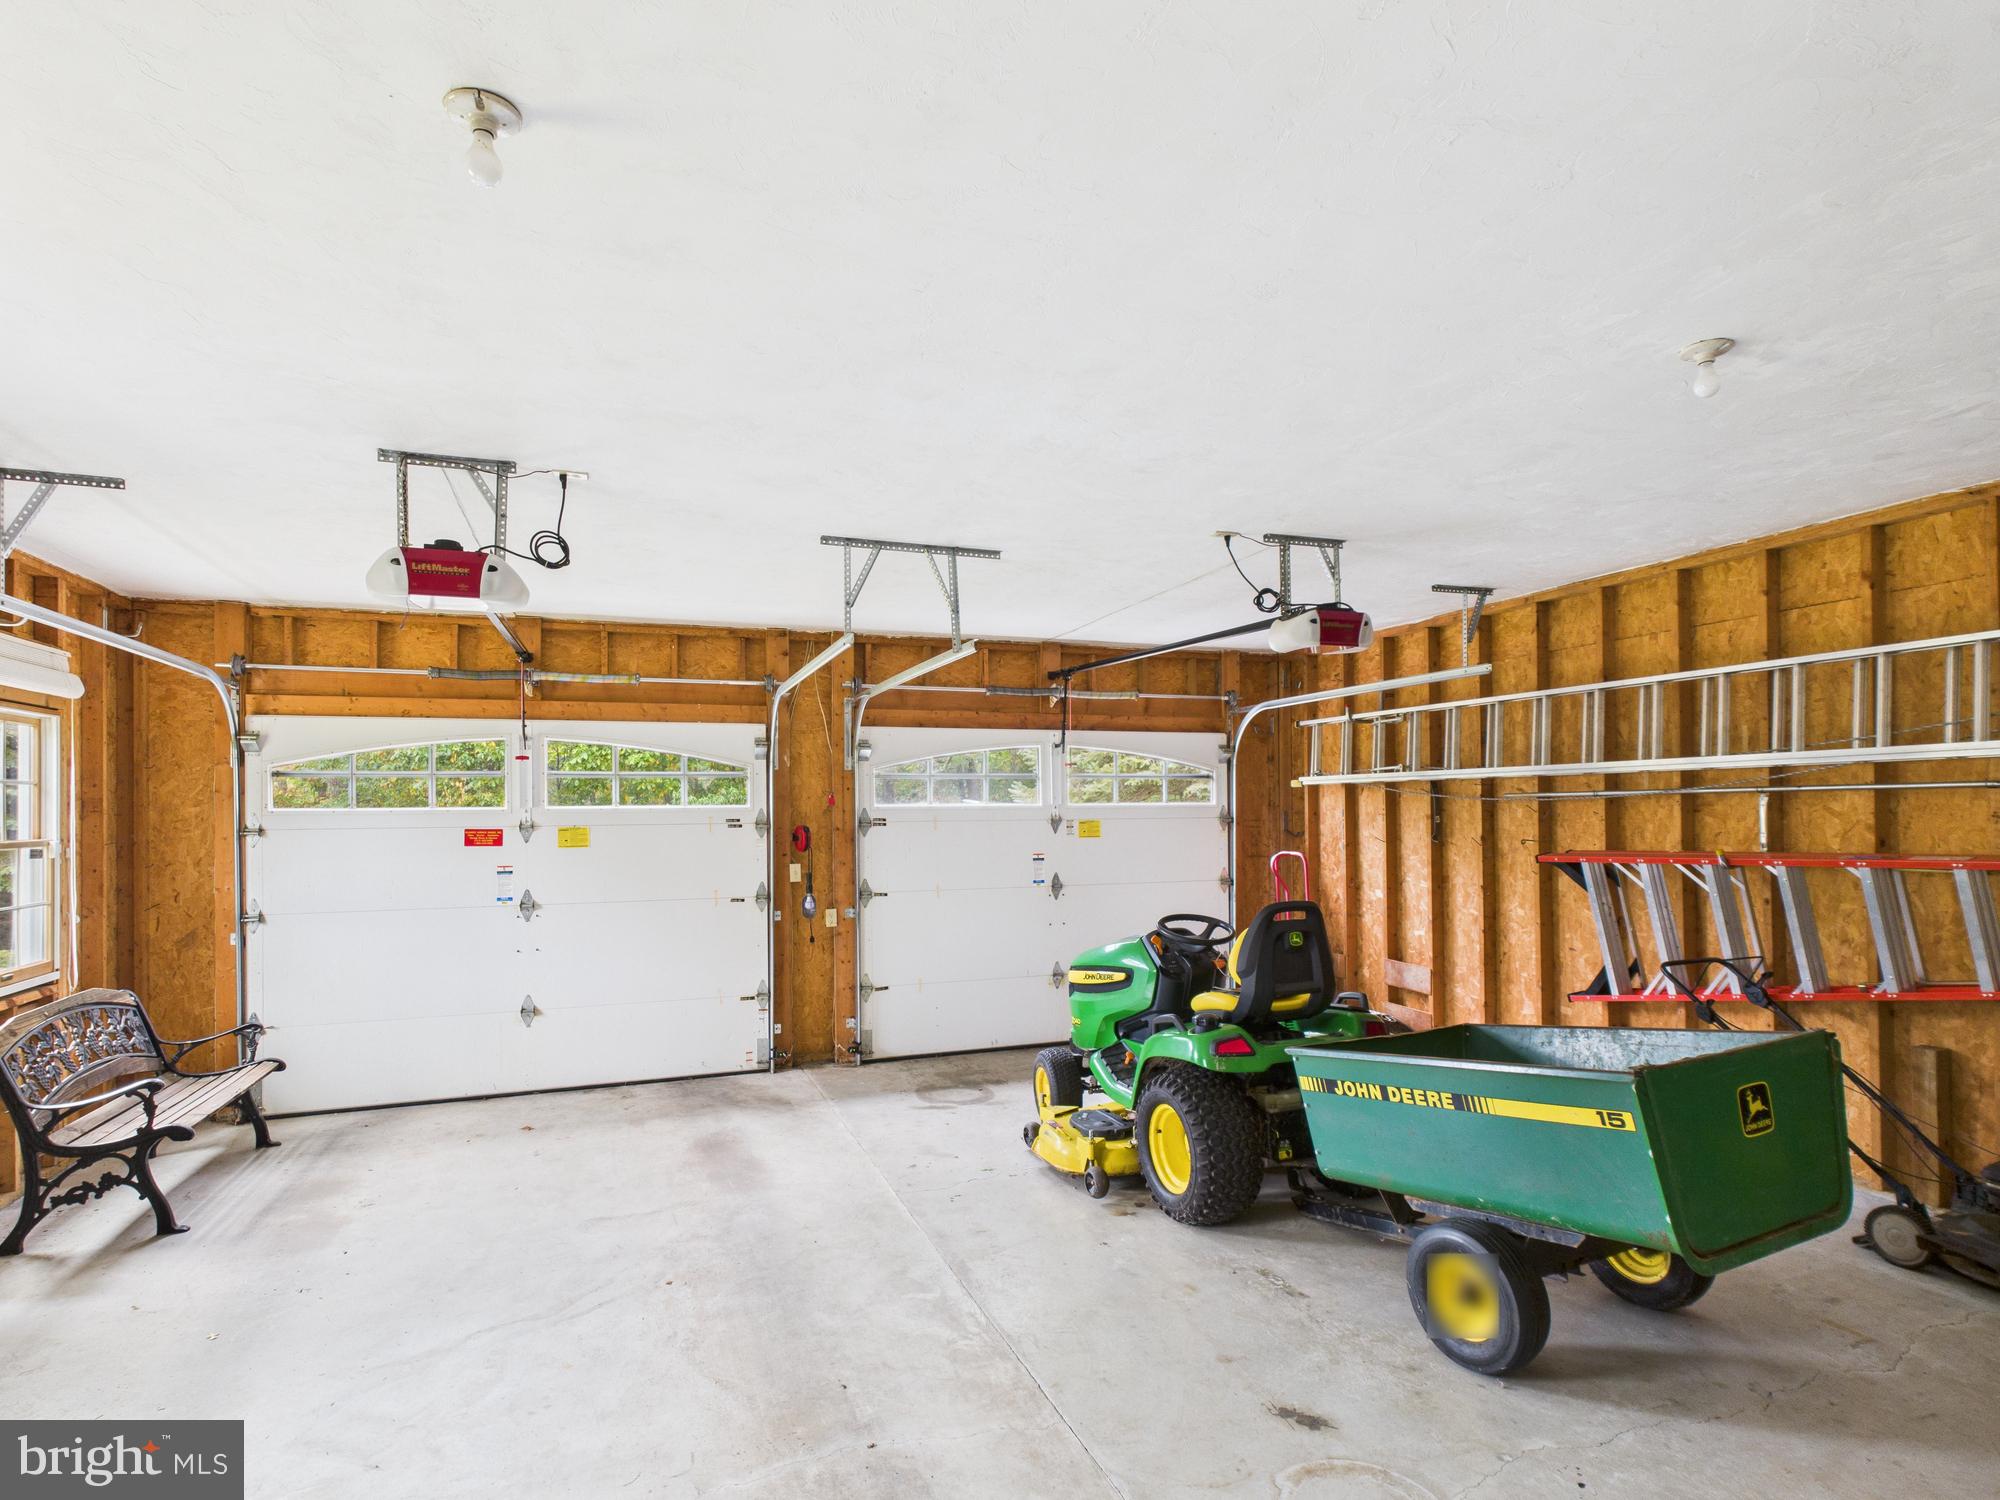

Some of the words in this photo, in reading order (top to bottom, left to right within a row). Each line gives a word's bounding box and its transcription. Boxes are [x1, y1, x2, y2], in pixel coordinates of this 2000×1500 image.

[411, 561, 470, 573] LiftMaster
[1334, 1080, 1382, 1101] JOHN
[1386, 1086, 1455, 1110] DEERE
[1596, 1111, 1626, 1128] 15
